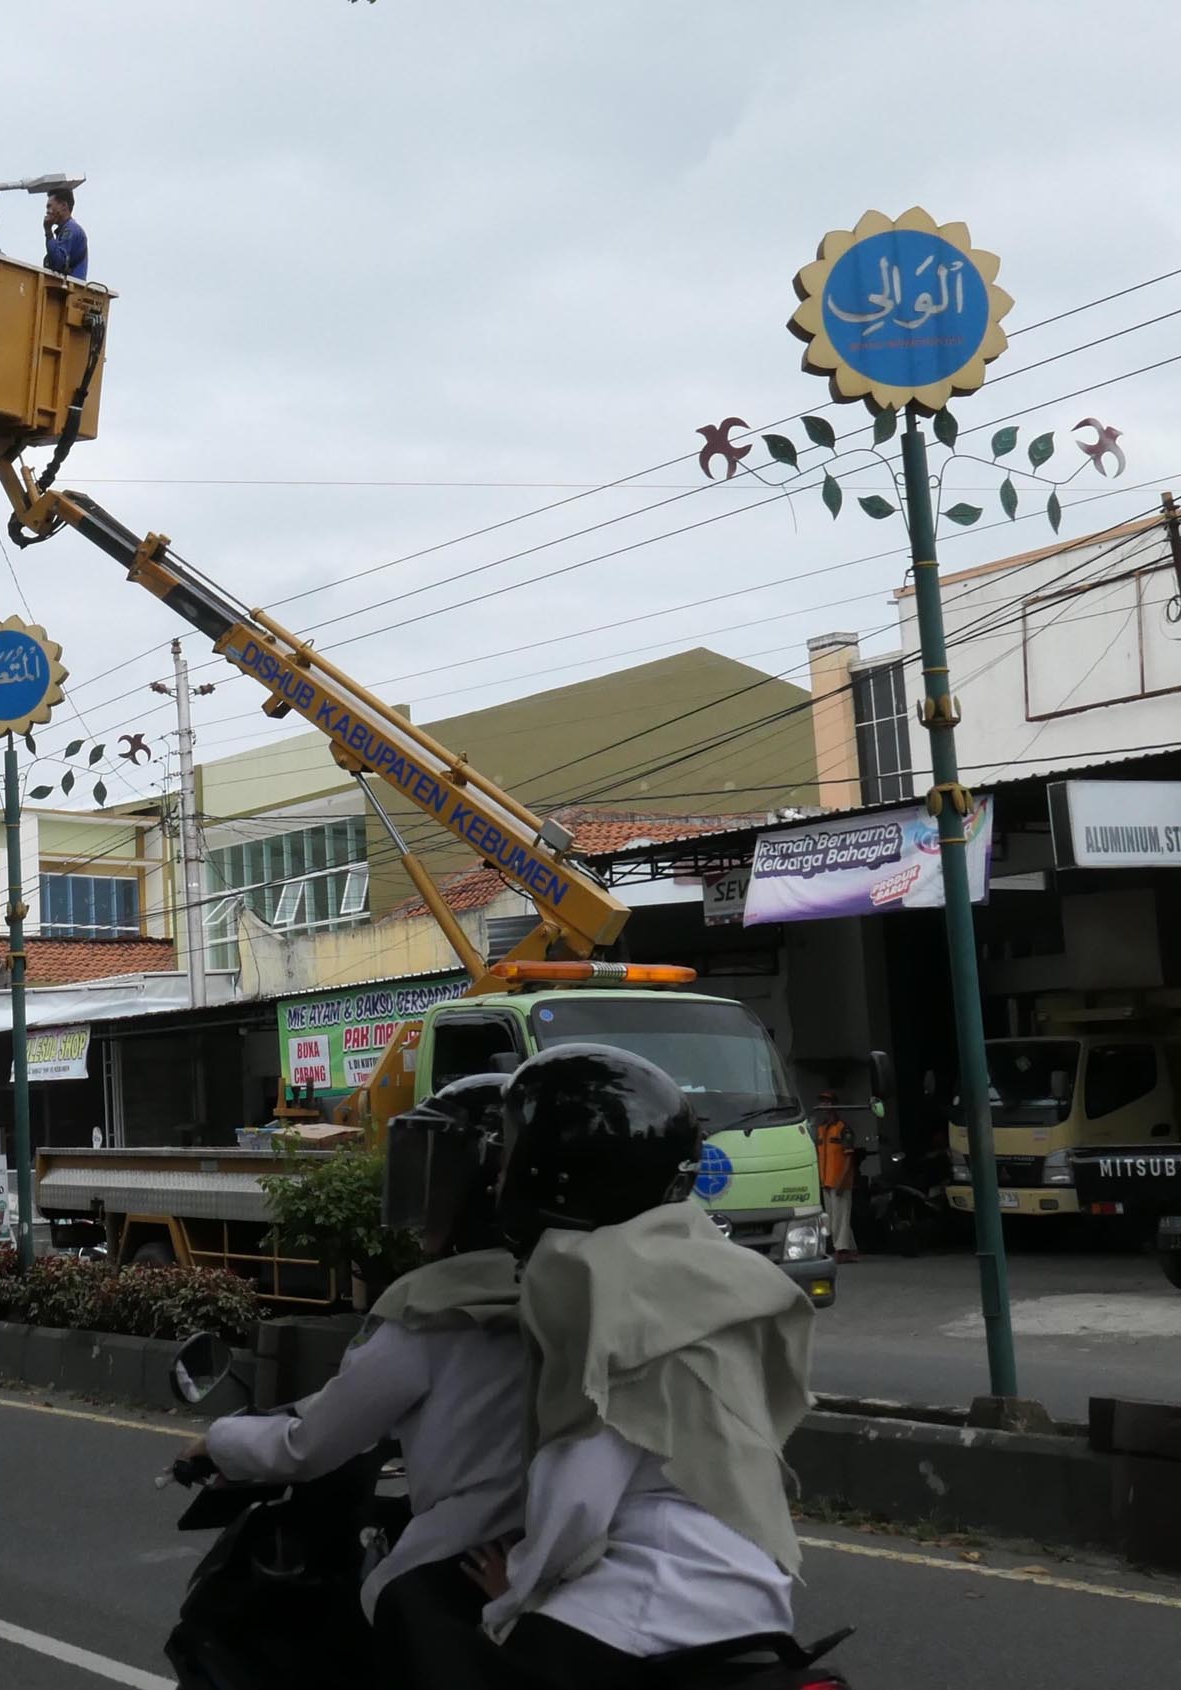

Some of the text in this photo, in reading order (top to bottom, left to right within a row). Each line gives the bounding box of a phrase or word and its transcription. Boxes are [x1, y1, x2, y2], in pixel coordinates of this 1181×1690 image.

[240, 641, 568, 905] DISHUB KABUPATEN KEBUMEN
[758, 835, 813, 857] Rumah
[816, 826, 899, 851] Berwarna,
[1085, 826, 1164, 854] ALUMINIUM,
[754, 839, 899, 876] Keluarga Bahagia!
[287, 1006, 307, 1030] MIE
[309, 1001, 341, 1027] AYAM
[344, 1001, 353, 1021] &
[356, 990, 394, 1019] BAKSO
[58, 1030, 87, 1061] SHOP
[297, 1042, 320, 1058] BUKA
[344, 1024, 369, 1050] PAK
[294, 1065, 326, 1084] CABANG
[1099, 1158, 1176, 1177] MITSUB
